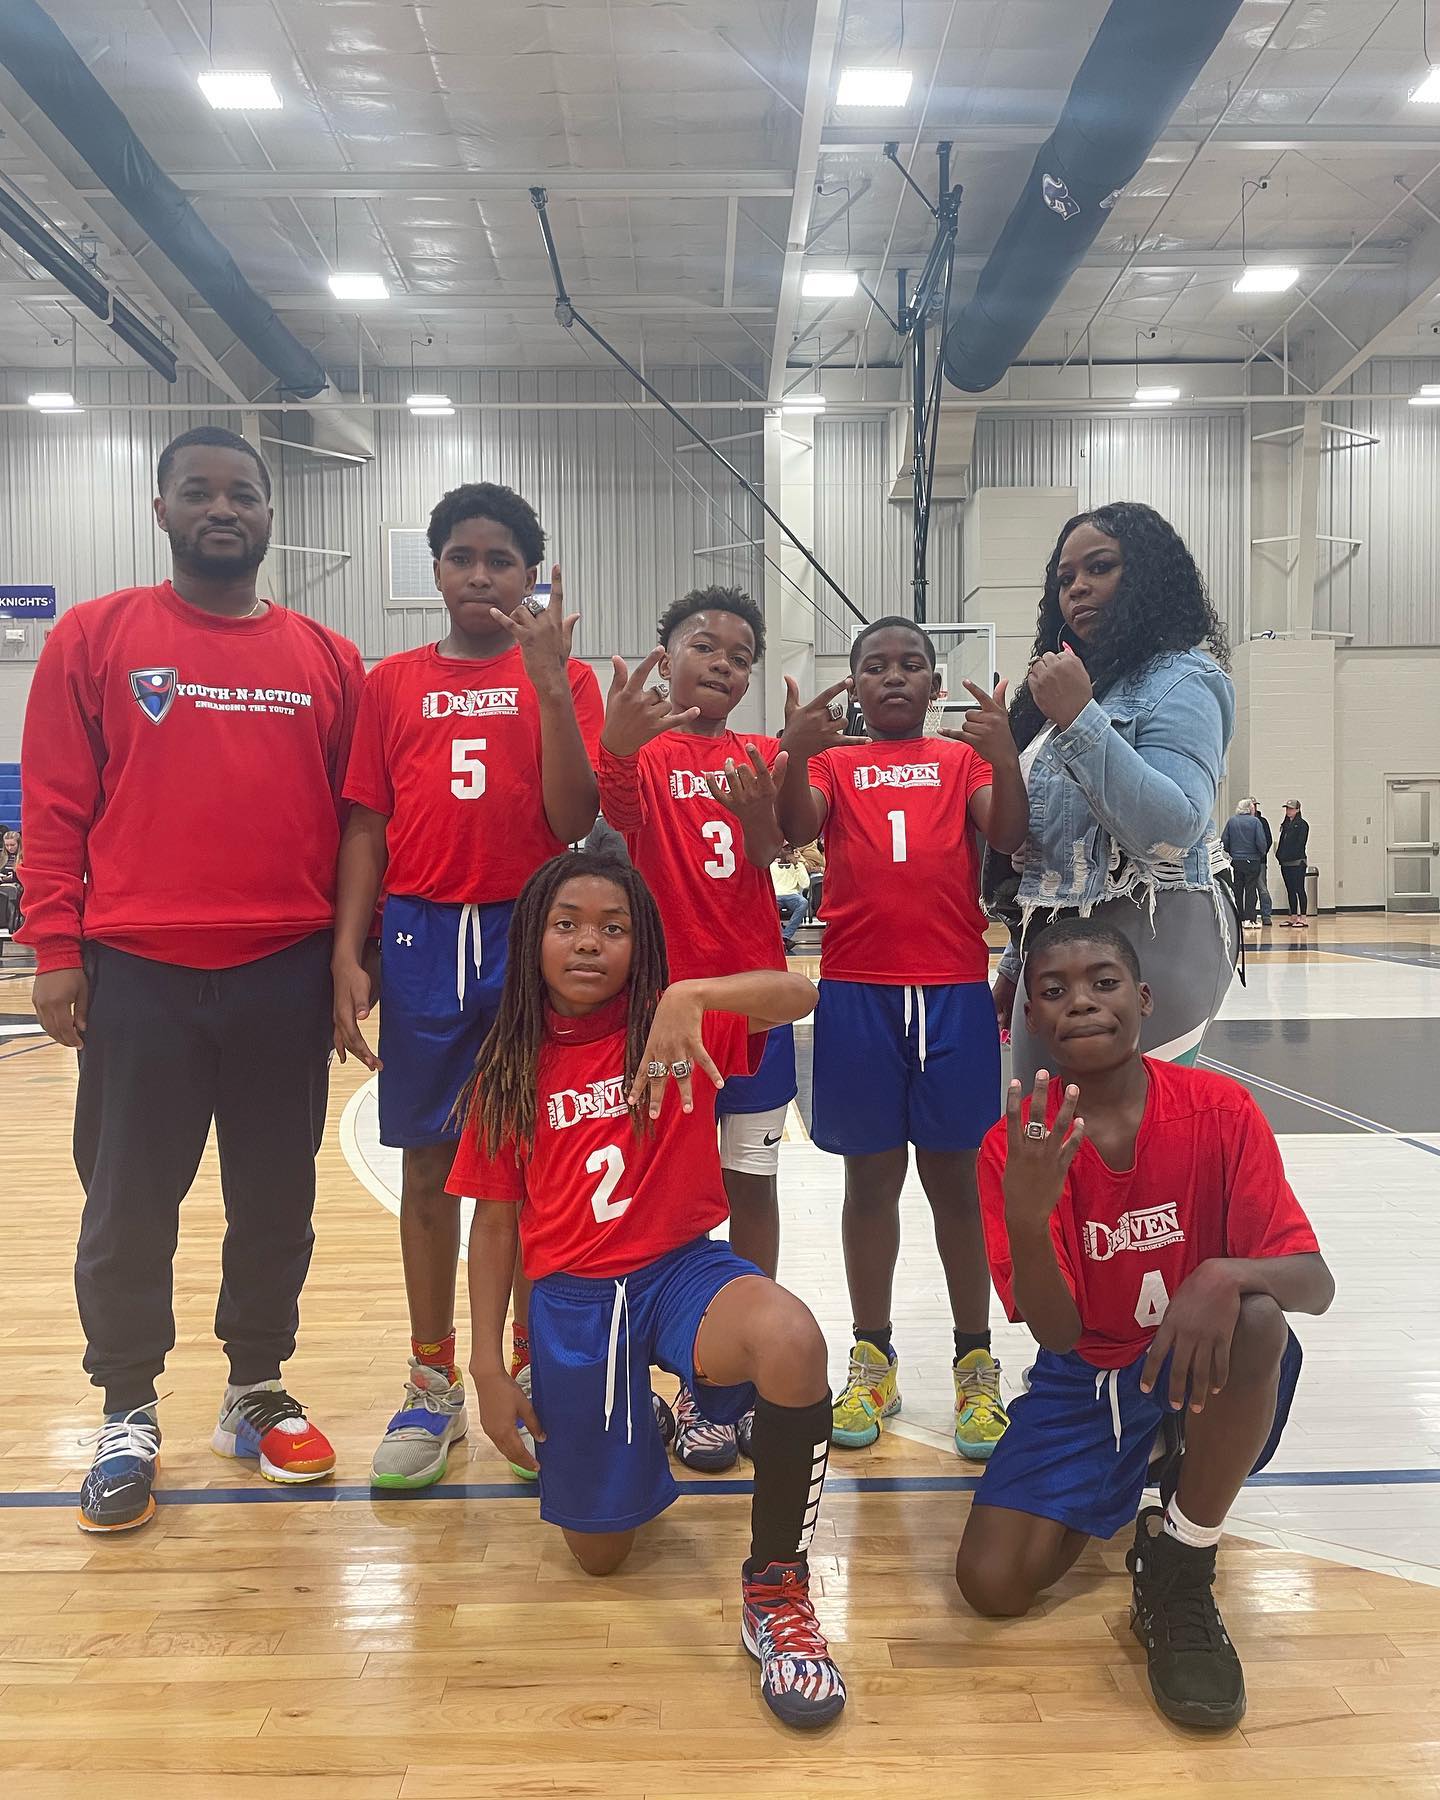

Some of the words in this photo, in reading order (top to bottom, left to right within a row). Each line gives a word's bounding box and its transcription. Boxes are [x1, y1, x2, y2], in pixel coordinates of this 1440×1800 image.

[0, 597, 49, 607] KNIGHTS
[176, 683, 312, 706] YOUTH-N-ACTION
[195, 700, 246, 712] ENHANCING
[248, 704, 267, 712] THE
[268, 706, 295, 716] YOUTH
[450, 738, 487, 800] 5
[701, 820, 736, 878] 3
[887, 810, 907, 862] 1
[585, 1144, 633, 1224] 2
[1133, 1269, 1170, 1329] 4
